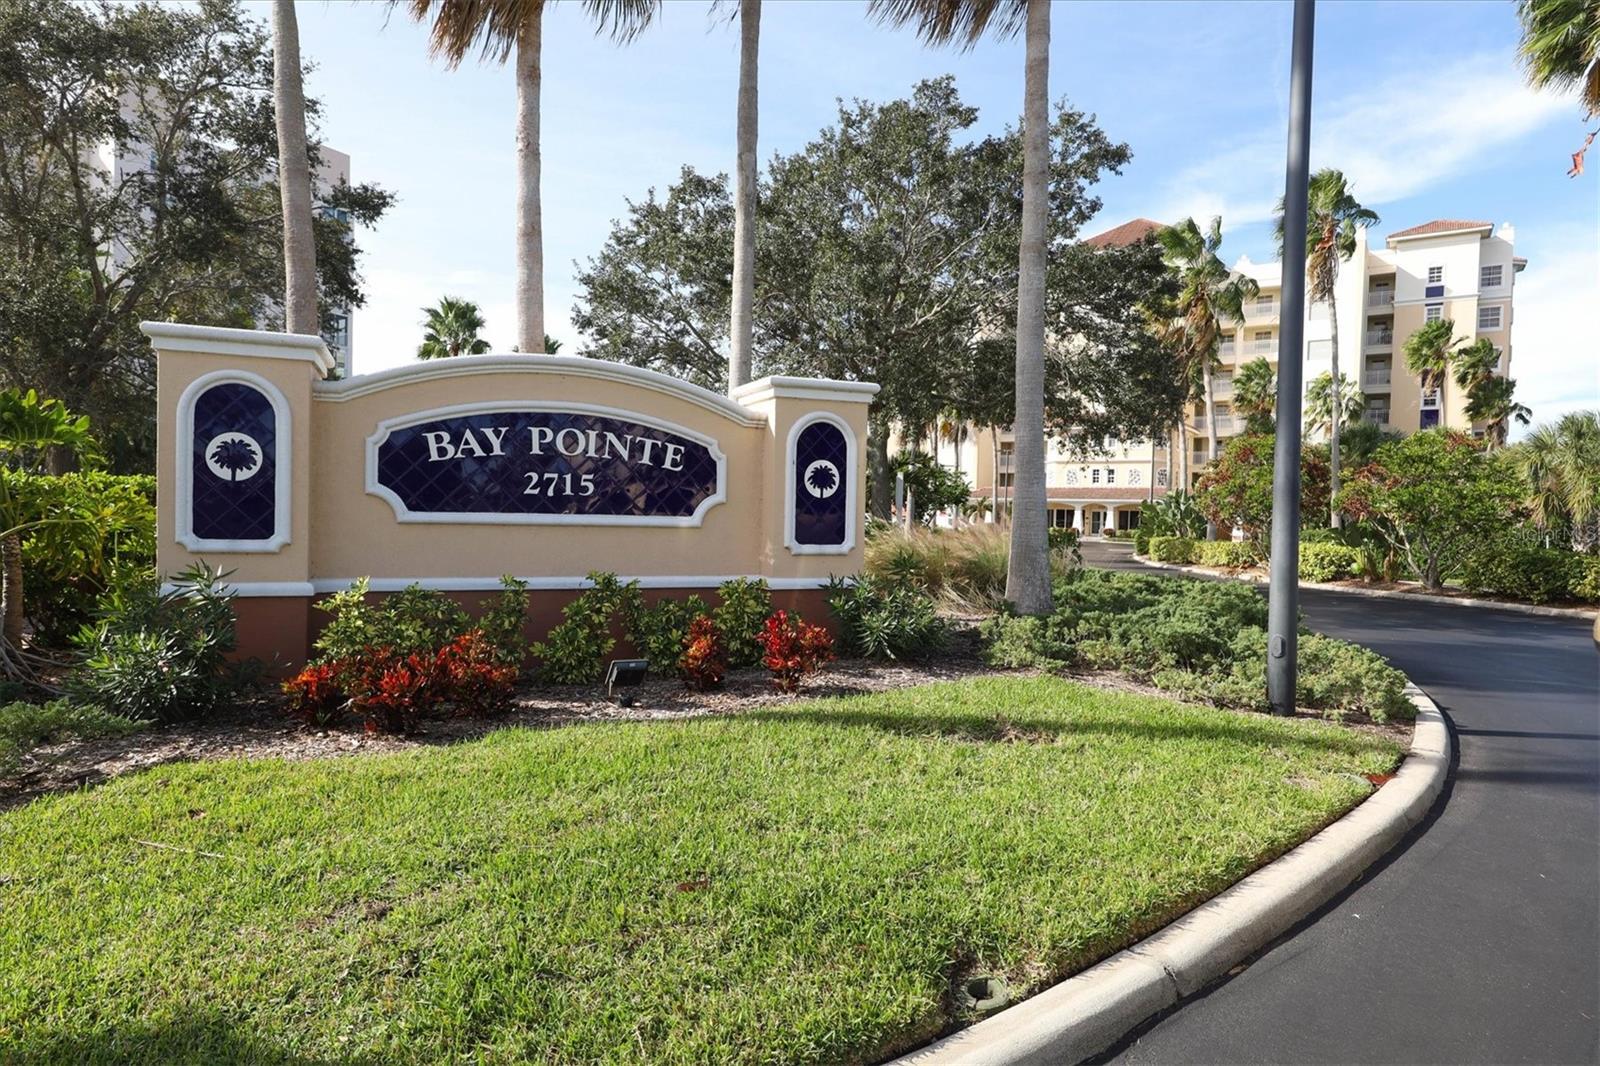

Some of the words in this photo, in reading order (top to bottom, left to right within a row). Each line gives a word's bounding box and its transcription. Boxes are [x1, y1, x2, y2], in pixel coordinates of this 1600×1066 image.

[422, 426, 509, 462] BAY
[527, 426, 686, 472] POINTE
[523, 472, 595, 497] 2715
